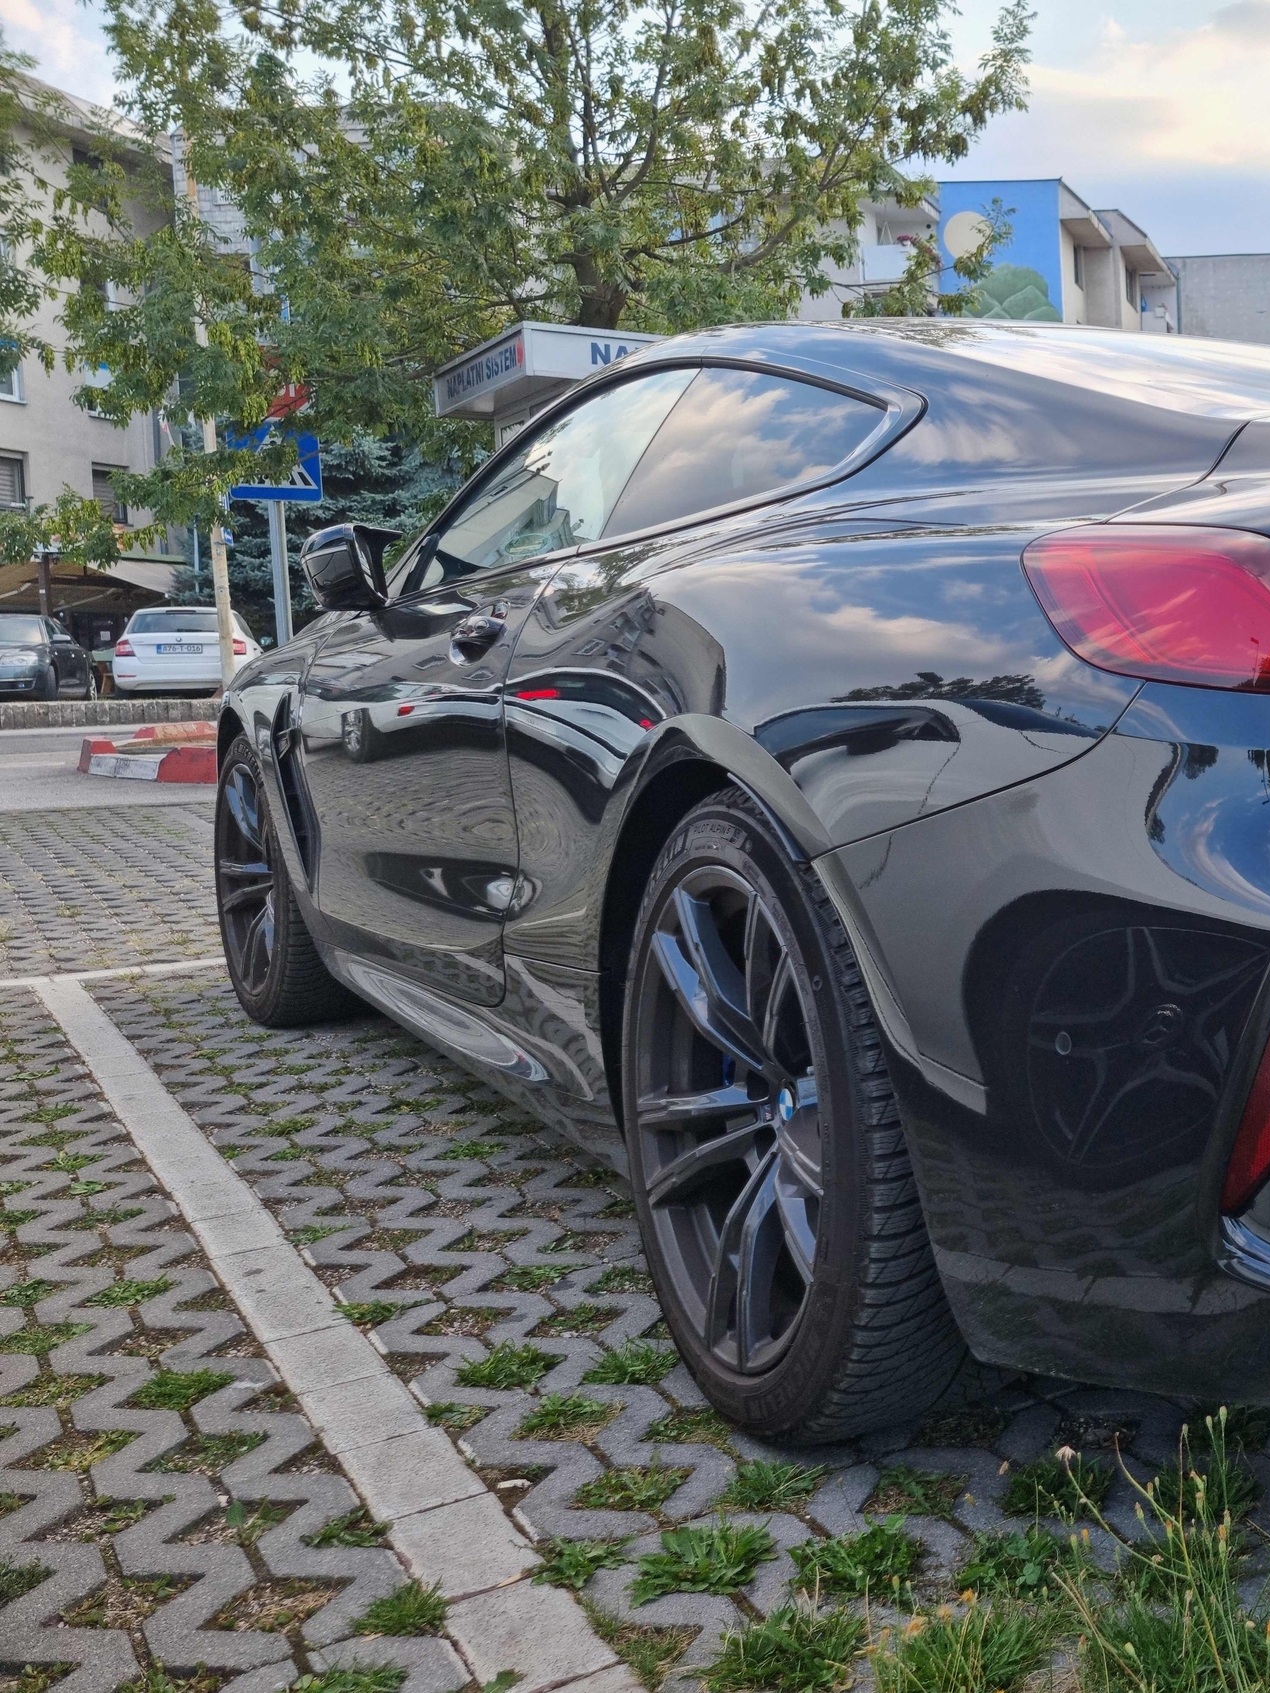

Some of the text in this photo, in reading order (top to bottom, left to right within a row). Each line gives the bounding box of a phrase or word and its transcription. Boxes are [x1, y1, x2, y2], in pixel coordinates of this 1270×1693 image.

[446, 344, 518, 399] NAPLATNI SISTEM
[162, 644, 202, 653] A76-T-016
